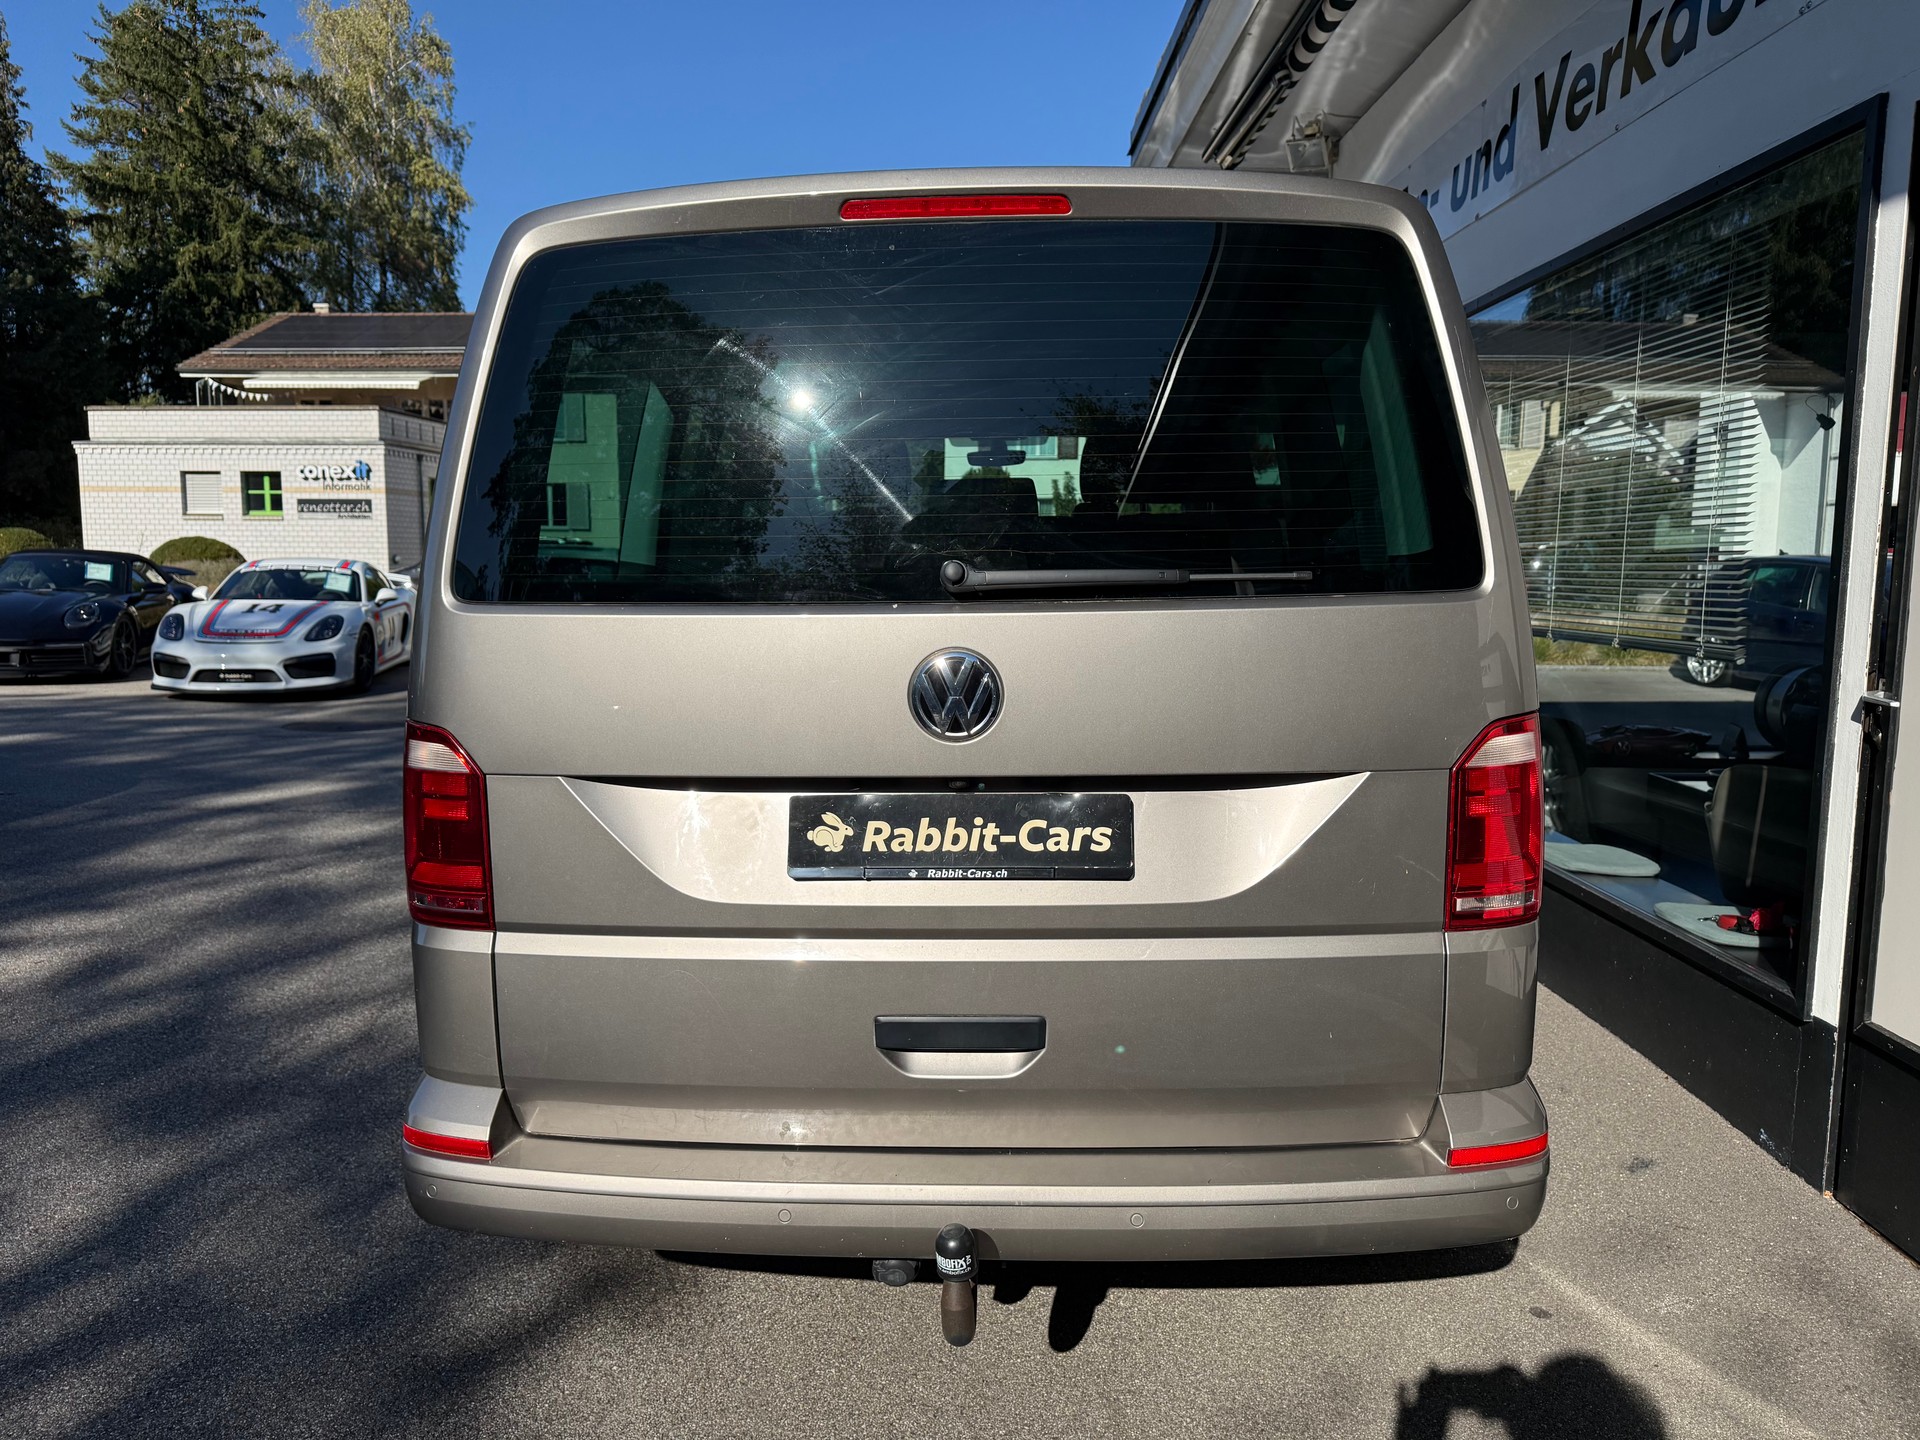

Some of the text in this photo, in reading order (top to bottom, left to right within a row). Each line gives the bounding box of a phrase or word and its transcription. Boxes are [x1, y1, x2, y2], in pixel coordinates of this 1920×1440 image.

[1450, 83, 1520, 213] und
[242, 603, 285, 613] 14
[862, 816, 1112, 852] Rabbit-Cars
[927, 868, 1008, 878] Rabbit-Cars.ch
